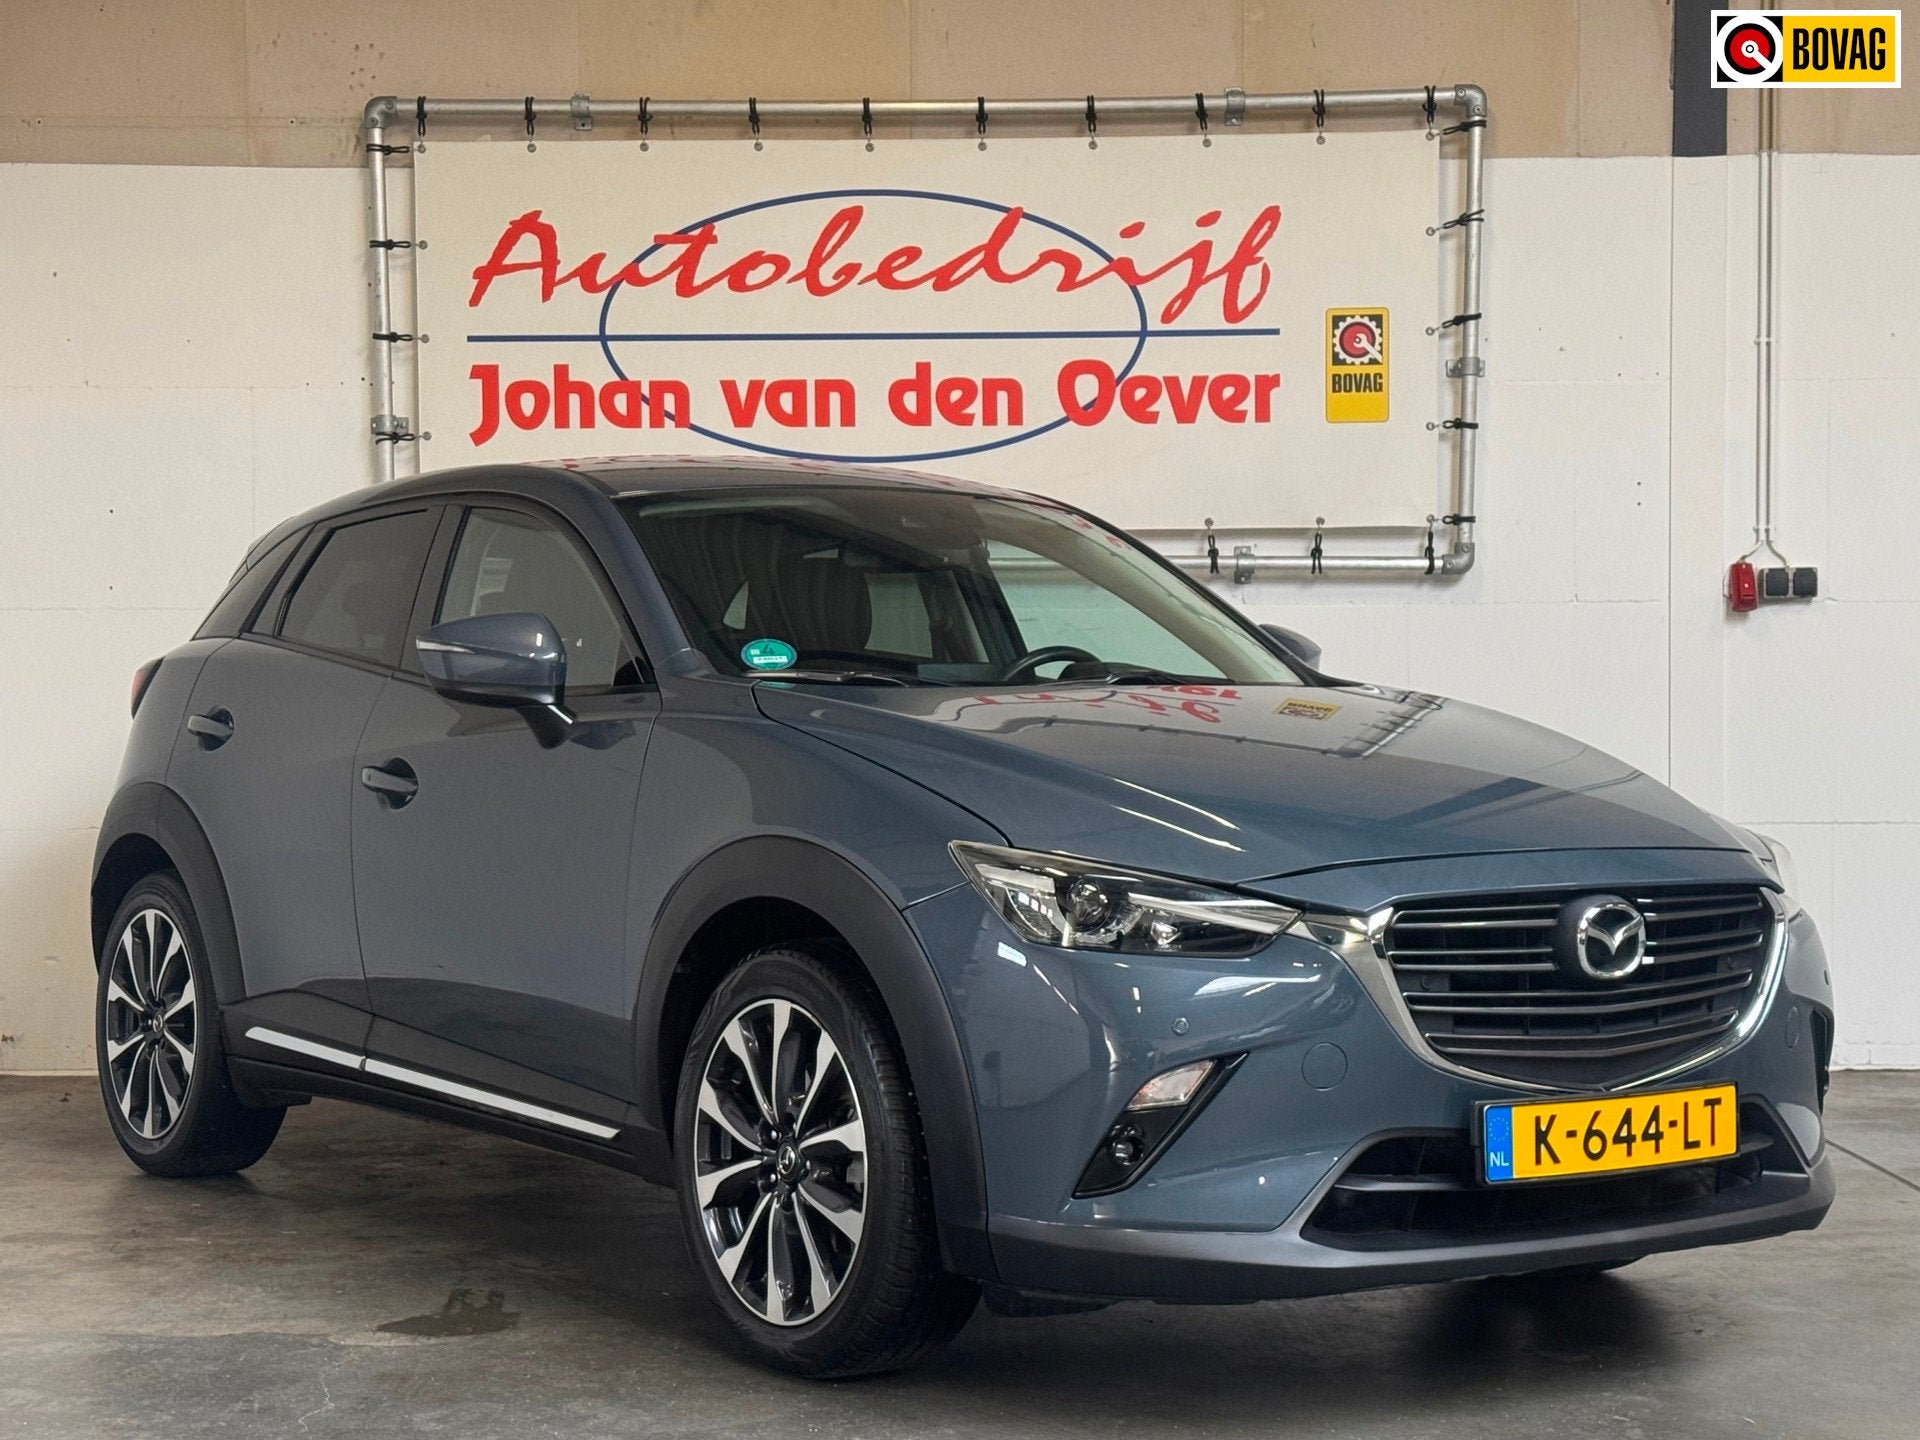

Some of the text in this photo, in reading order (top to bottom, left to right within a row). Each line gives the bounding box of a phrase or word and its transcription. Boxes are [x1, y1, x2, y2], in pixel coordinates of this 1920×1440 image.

[468, 205, 1281, 325] Autobedrijf
[470, 359, 1281, 447] Johan van den Oever
[1331, 372, 1384, 394] BOVAG
[1490, 1152, 1509, 1167] NL
[1534, 1097, 1722, 1166] K-644-LT
